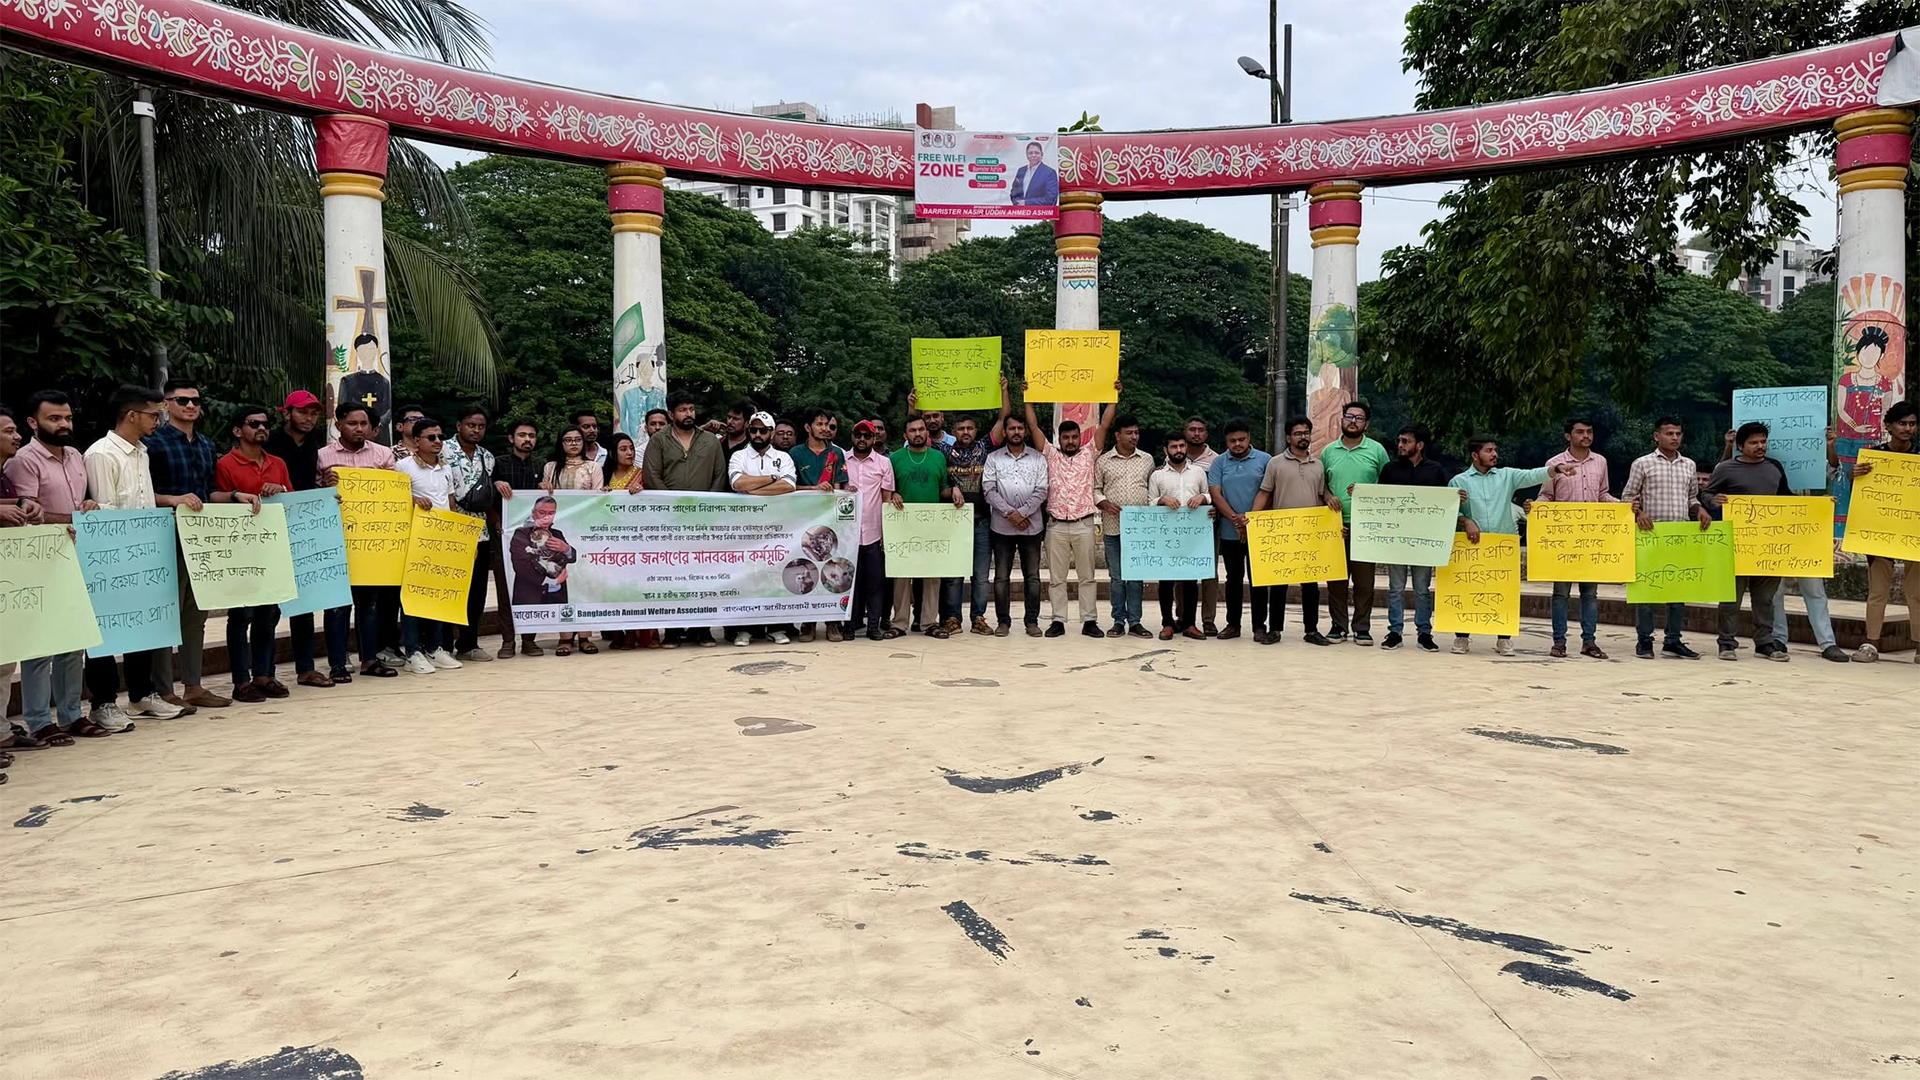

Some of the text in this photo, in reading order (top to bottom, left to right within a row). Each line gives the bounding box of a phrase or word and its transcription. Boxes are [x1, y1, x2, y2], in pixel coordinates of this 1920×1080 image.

[918, 153, 966, 163] FREE WI-FI
[919, 163, 965, 178] ZONE
[628, 504, 647, 514] হোক
[649, 504, 670, 513] সকল
[672, 504, 696, 514] প্রাণের
[698, 502, 726, 513] নিরাপদ
[85, 548, 120, 567] সবার
[639, 550, 689, 567] জনগণের
[691, 550, 745, 565] মানববন্ধন
[1469, 592, 1505, 607] হোক
[577, 605, 718, 619] Bangladesh Animal Welfare Association
[722, 605, 761, 613] বাংলাদেশ
